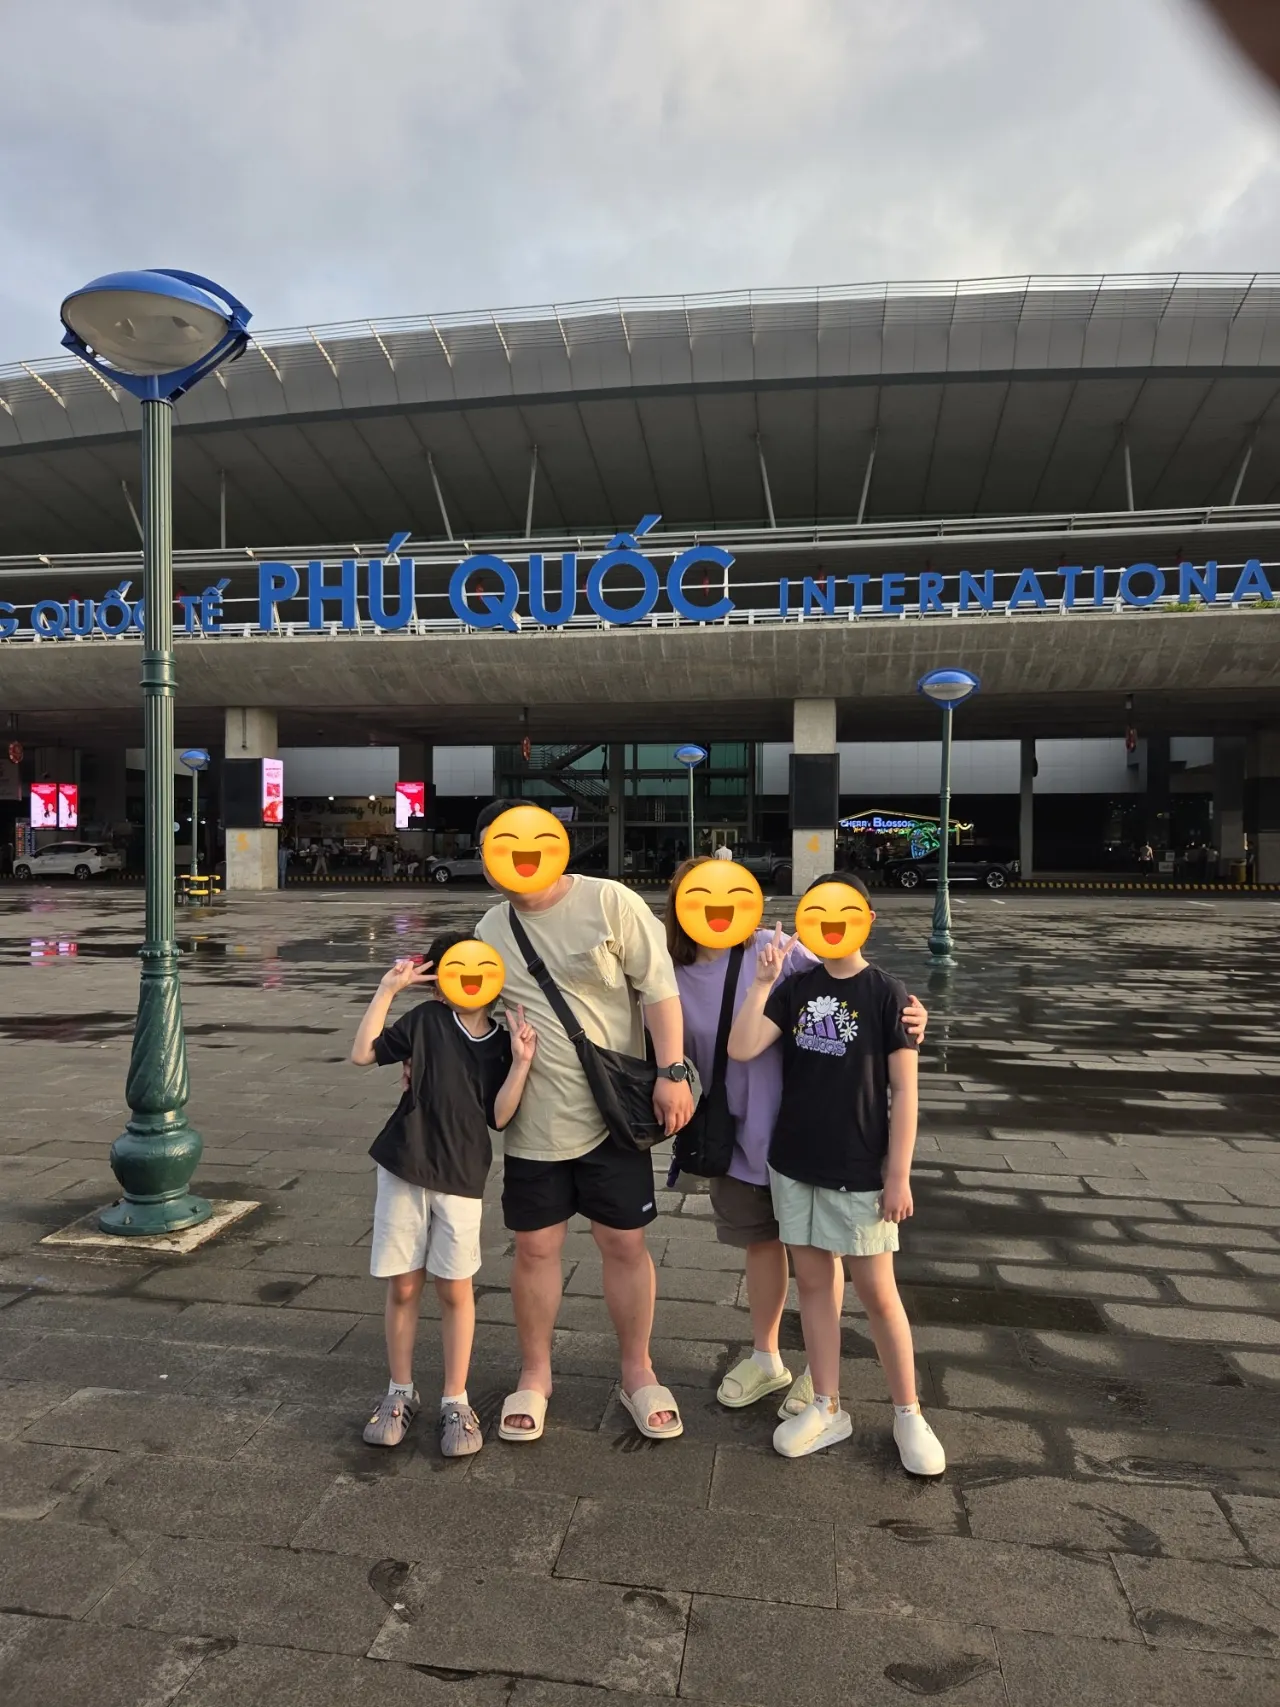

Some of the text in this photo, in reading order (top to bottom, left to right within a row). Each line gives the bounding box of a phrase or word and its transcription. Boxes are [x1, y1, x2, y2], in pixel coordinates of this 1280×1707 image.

[180, 578, 231, 633] TẾ
[259, 532, 415, 632] PHÚ
[449, 514, 736, 632] QUỐC
[779, 559, 1275, 616] INTERNATIONA
